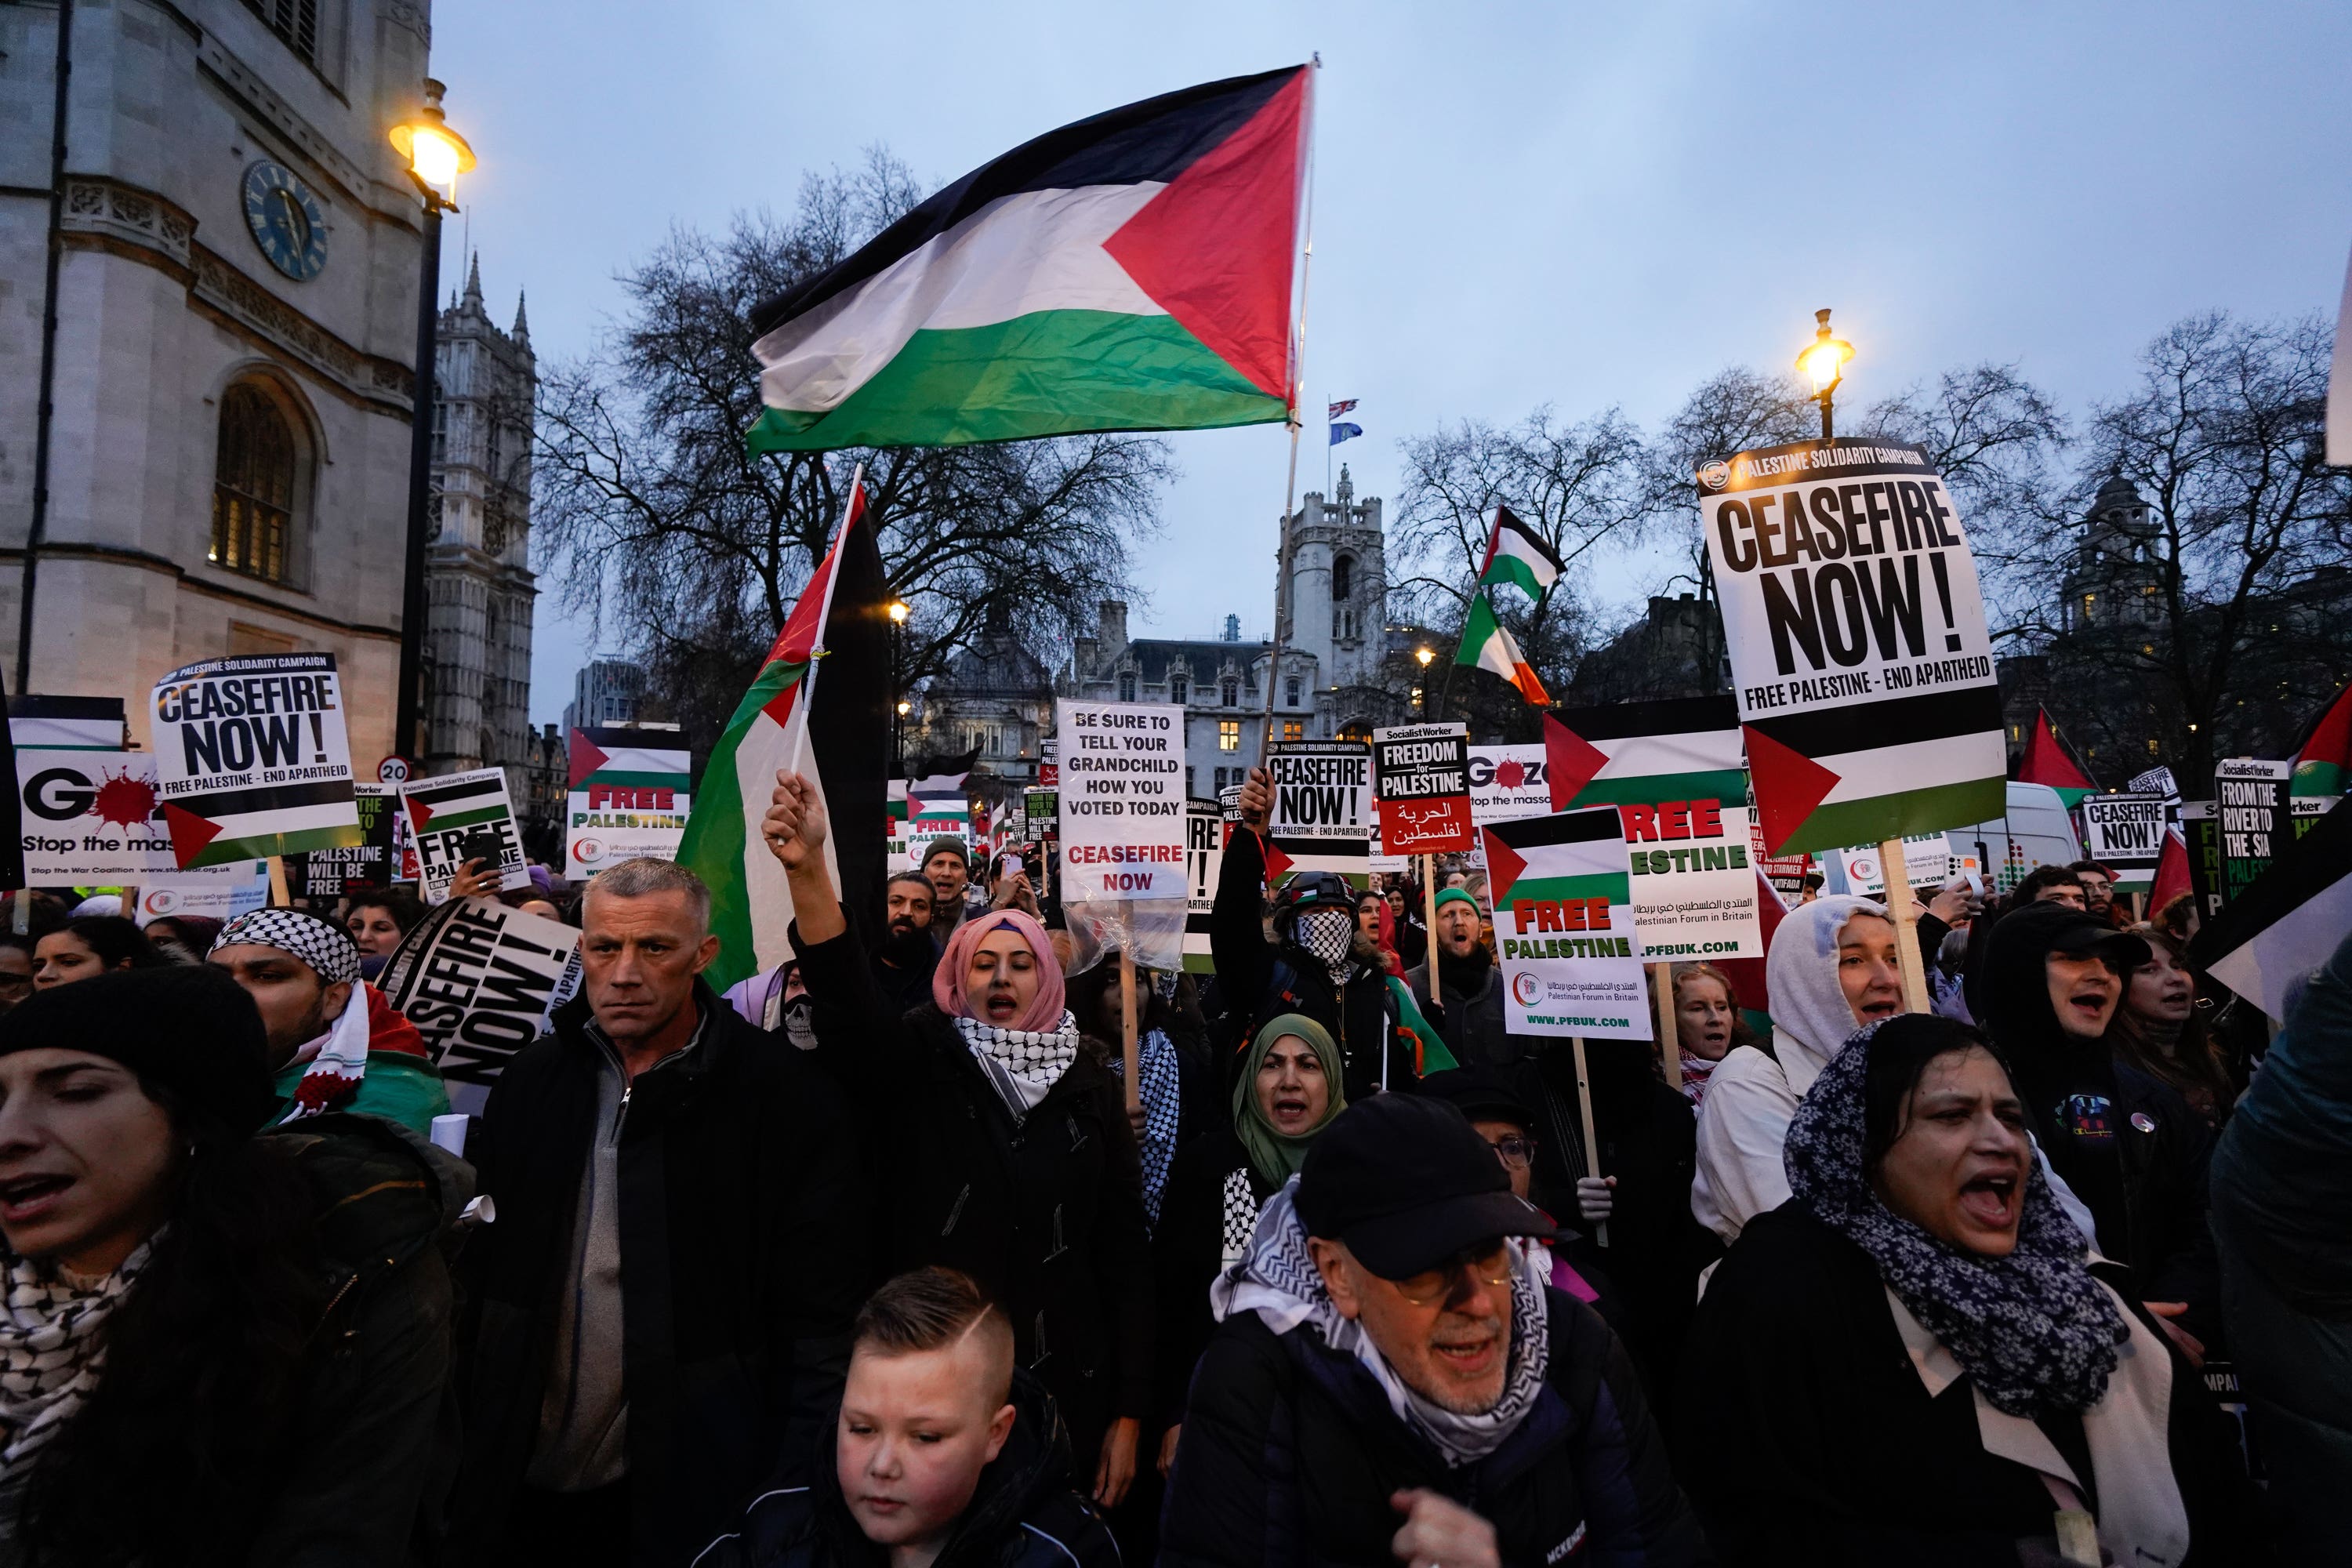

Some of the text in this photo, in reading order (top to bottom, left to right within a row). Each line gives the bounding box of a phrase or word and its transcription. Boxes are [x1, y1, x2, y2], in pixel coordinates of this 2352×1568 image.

[1739, 452, 1809, 479] PALESTINE
[1812, 447, 1875, 468] SOLIDARITY
[1876, 447, 1925, 466] CAMPAIGN
[1717, 481, 1961, 572] CEASEFIRE
[1760, 552, 1962, 676] NOW!
[180, 656, 327, 677] PALESTINE SOLIDARITY CAMPAIGN
[1744, 655, 1991, 710] FREE PALESTINE END APARTHEID
[158, 675, 336, 723] CEASEFIRE
[1076, 713, 1171, 730] BE SURE TO
[181, 713, 327, 776] NOW!
[1079, 735, 1167, 752] TELL YOUR
[1383, 741, 1457, 766] FREEDOM
[383, 764, 406, 779] 20
[1069, 757, 1178, 773] GRANDCHILD
[1270, 758, 1367, 786] CEASEFIRE
[1416, 764, 1428, 773] for
[165, 764, 347, 794] FREE PALESTINE END APARTHEID
[403, 771, 500, 793] Palestine Solidarity Campaign
[1087, 780, 1163, 794] HOW YOU
[1382, 771, 1464, 797] PALESTINE
[2140, 779, 2171, 792] OW!
[589, 784, 674, 810] FREE
[1221, 795, 1240, 806] FREE
[1471, 797, 1490, 807] top
[1493, 796, 1510, 804] the
[2222, 782, 2278, 806] FROM THE
[357, 798, 383, 812] THE
[1068, 801, 1180, 815] VOTED TODAY
[1186, 800, 1218, 811] CAMPAIGN
[1280, 786, 1357, 825] NOW!
[1398, 803, 1451, 823] الحرية
[2089, 803, 2162, 823] CEASEFIRE
[2291, 802, 2321, 812] rker
[359, 814, 375, 829] TO
[572, 812, 685, 829] PALESTINE
[1223, 810, 1243, 821] PALES
[1619, 798, 1724, 844] REE
[2223, 808, 2260, 831] RIVER
[2260, 808, 2273, 831] TO
[916, 819, 960, 833] FREE
[1283, 826, 1313, 835] PALESTINE
[1320, 827, 1332, 836] END
[1333, 828, 1367, 837] APARTHEID
[1393, 822, 1461, 845] لفلسطين
[417, 819, 517, 866] FRE
[2101, 822, 2160, 849] NOW!
[23, 836, 174, 855] Stop the mas
[2224, 833, 2250, 857] THE
[309, 846, 383, 862] PALESTINE
[1068, 844, 1183, 864] CEASEFIRE
[1630, 845, 1748, 876] ESTINE
[307, 863, 365, 878] WILL BE
[1773, 865, 1802, 875] STARMER
[307, 880, 341, 895] FREE
[430, 880, 446, 890] END
[1103, 873, 1152, 891] NOW
[1775, 879, 1800, 888] INTIFADA
[1657, 904, 1674, 913] في
[1676, 901, 1721, 913] الفلسطيني
[1723, 898, 1752, 909] المنتدى
[1512, 897, 1611, 935] FREE
[1635, 916, 1677, 926] alestinian
[1681, 914, 1708, 923] Forum
[1722, 912, 1752, 920] Britain
[1503, 938, 1632, 960] PALESTINE
[1641, 942, 1739, 956] .PFBUK.COM
[405, 904, 507, 1064] ASEFIRE
[1566, 983, 1577, 992] في
[1579, 982, 1613, 992] الفلسطيني
[1615, 982, 1637, 991] المنتدى
[1527, 1015, 1629, 1028] WWW.PFBUK.COM
